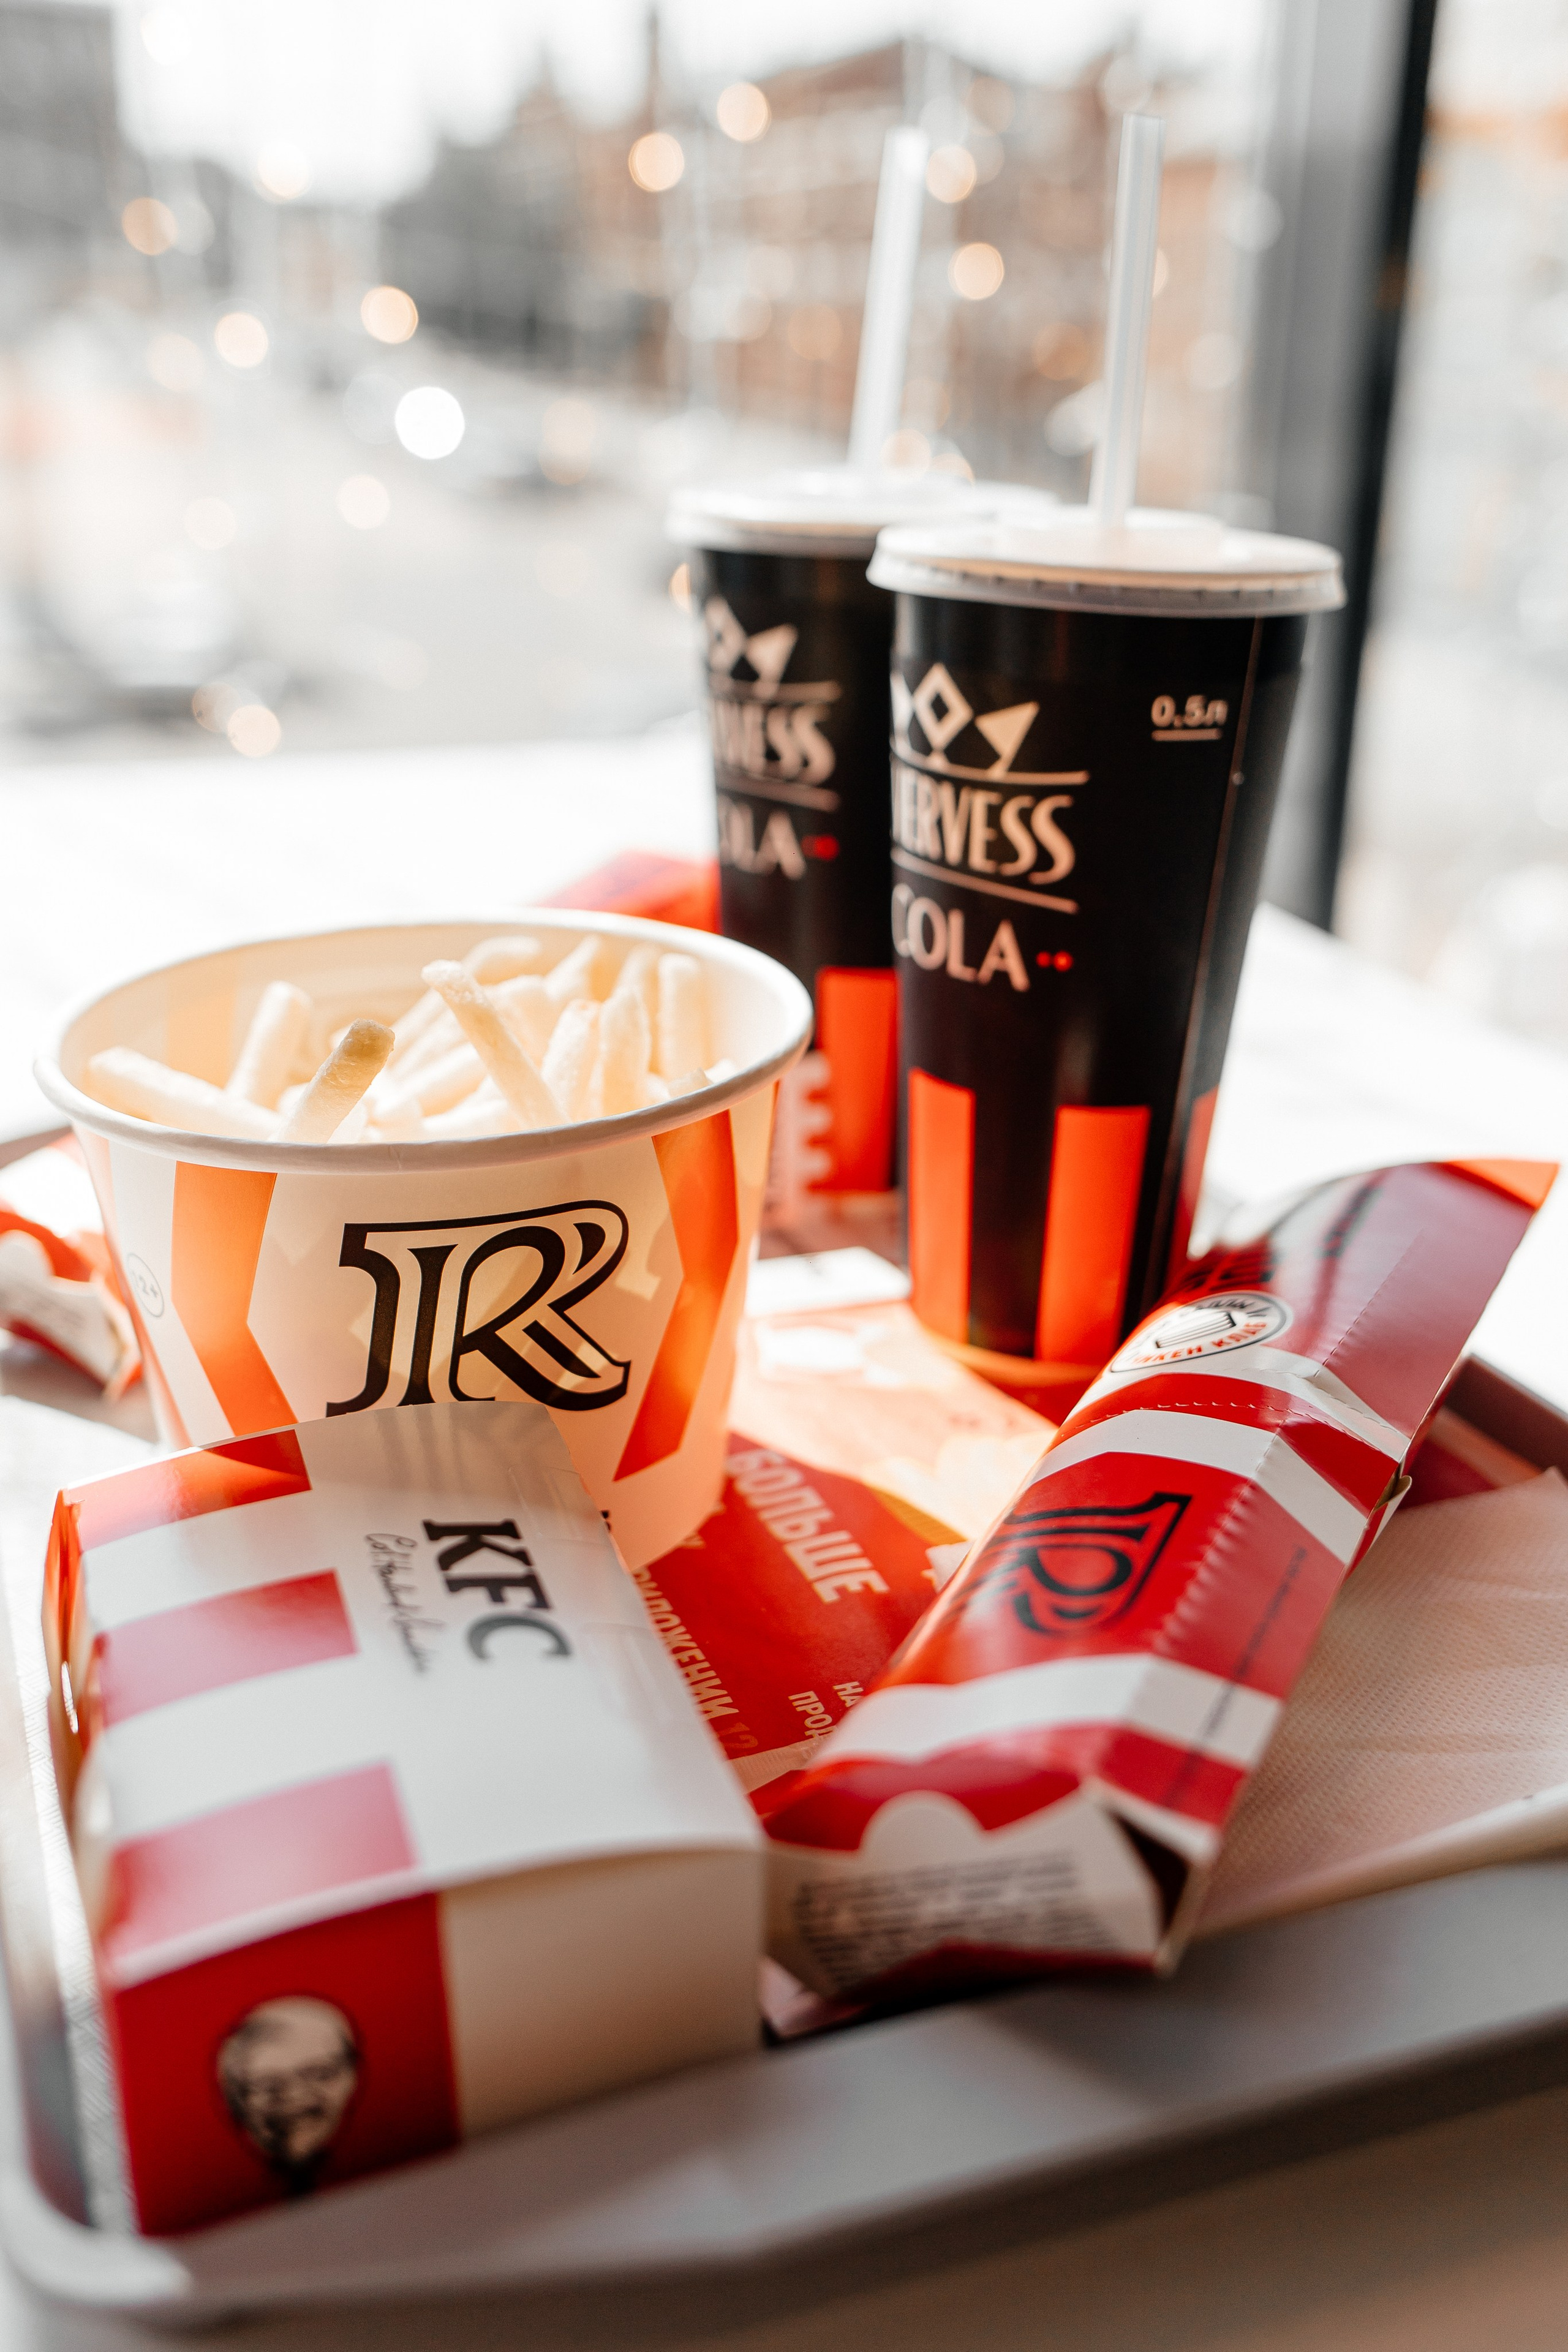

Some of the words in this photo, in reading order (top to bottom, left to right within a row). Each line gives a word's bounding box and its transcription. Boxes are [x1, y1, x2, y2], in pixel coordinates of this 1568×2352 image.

[891, 882, 1030, 992] COLA
[725, 1448, 889, 1604] БОЛЬШЕ
[423, 1518, 575, 1664] KFC
[832, 1681, 864, 1708] НА
